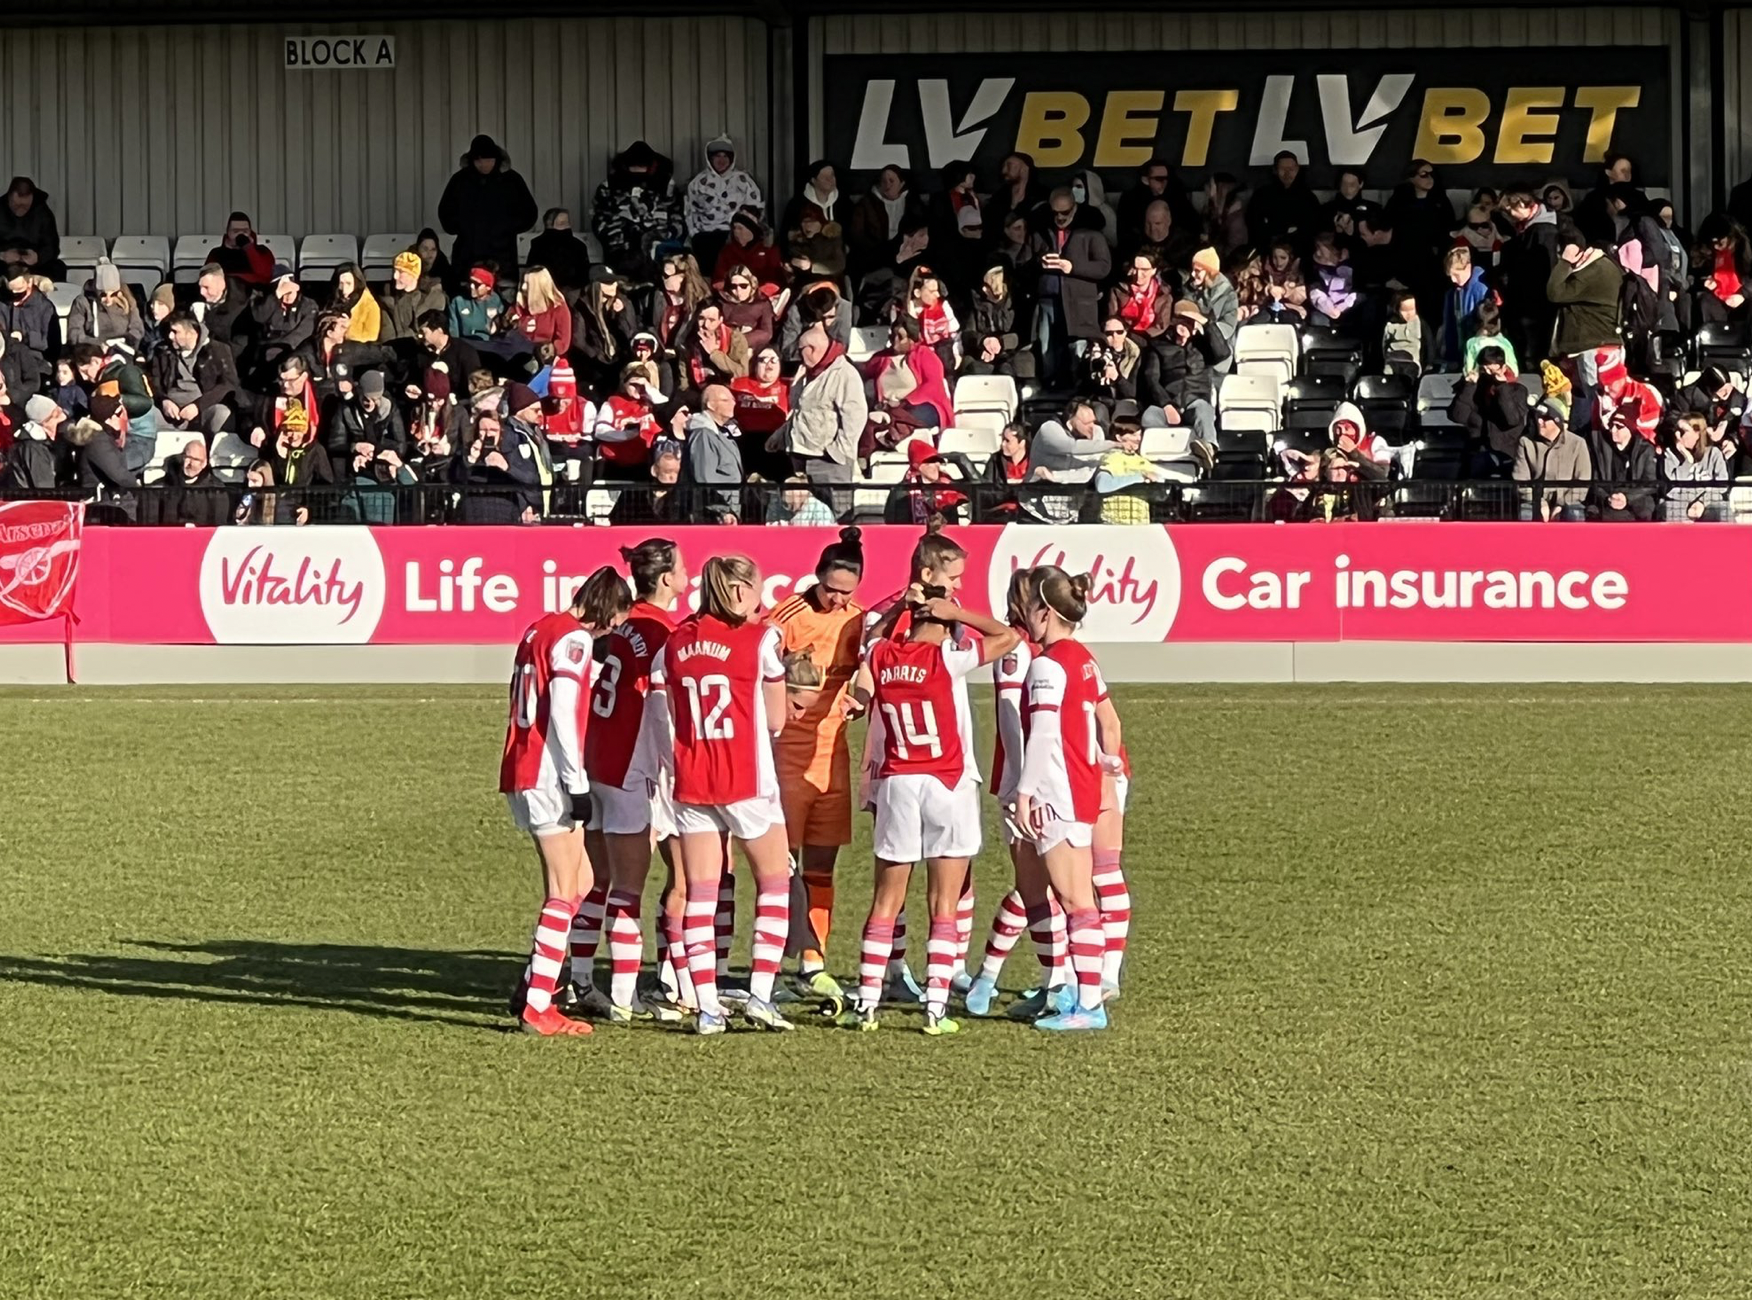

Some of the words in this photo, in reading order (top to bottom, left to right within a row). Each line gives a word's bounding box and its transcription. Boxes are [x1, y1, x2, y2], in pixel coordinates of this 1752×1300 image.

[286, 39, 367, 65] BLOCK
[375, 38, 393, 65] A
[222, 544, 364, 626] Vitality
[405, 556, 519, 613] Life
[1202, 556, 1311, 611] Car
[1335, 554, 1629, 610] insurance
[677, 640, 731, 662] MAANUM
[880, 665, 927, 685] PARRIS
[681, 674, 734, 740] 12
[881, 700, 943, 761] 14
